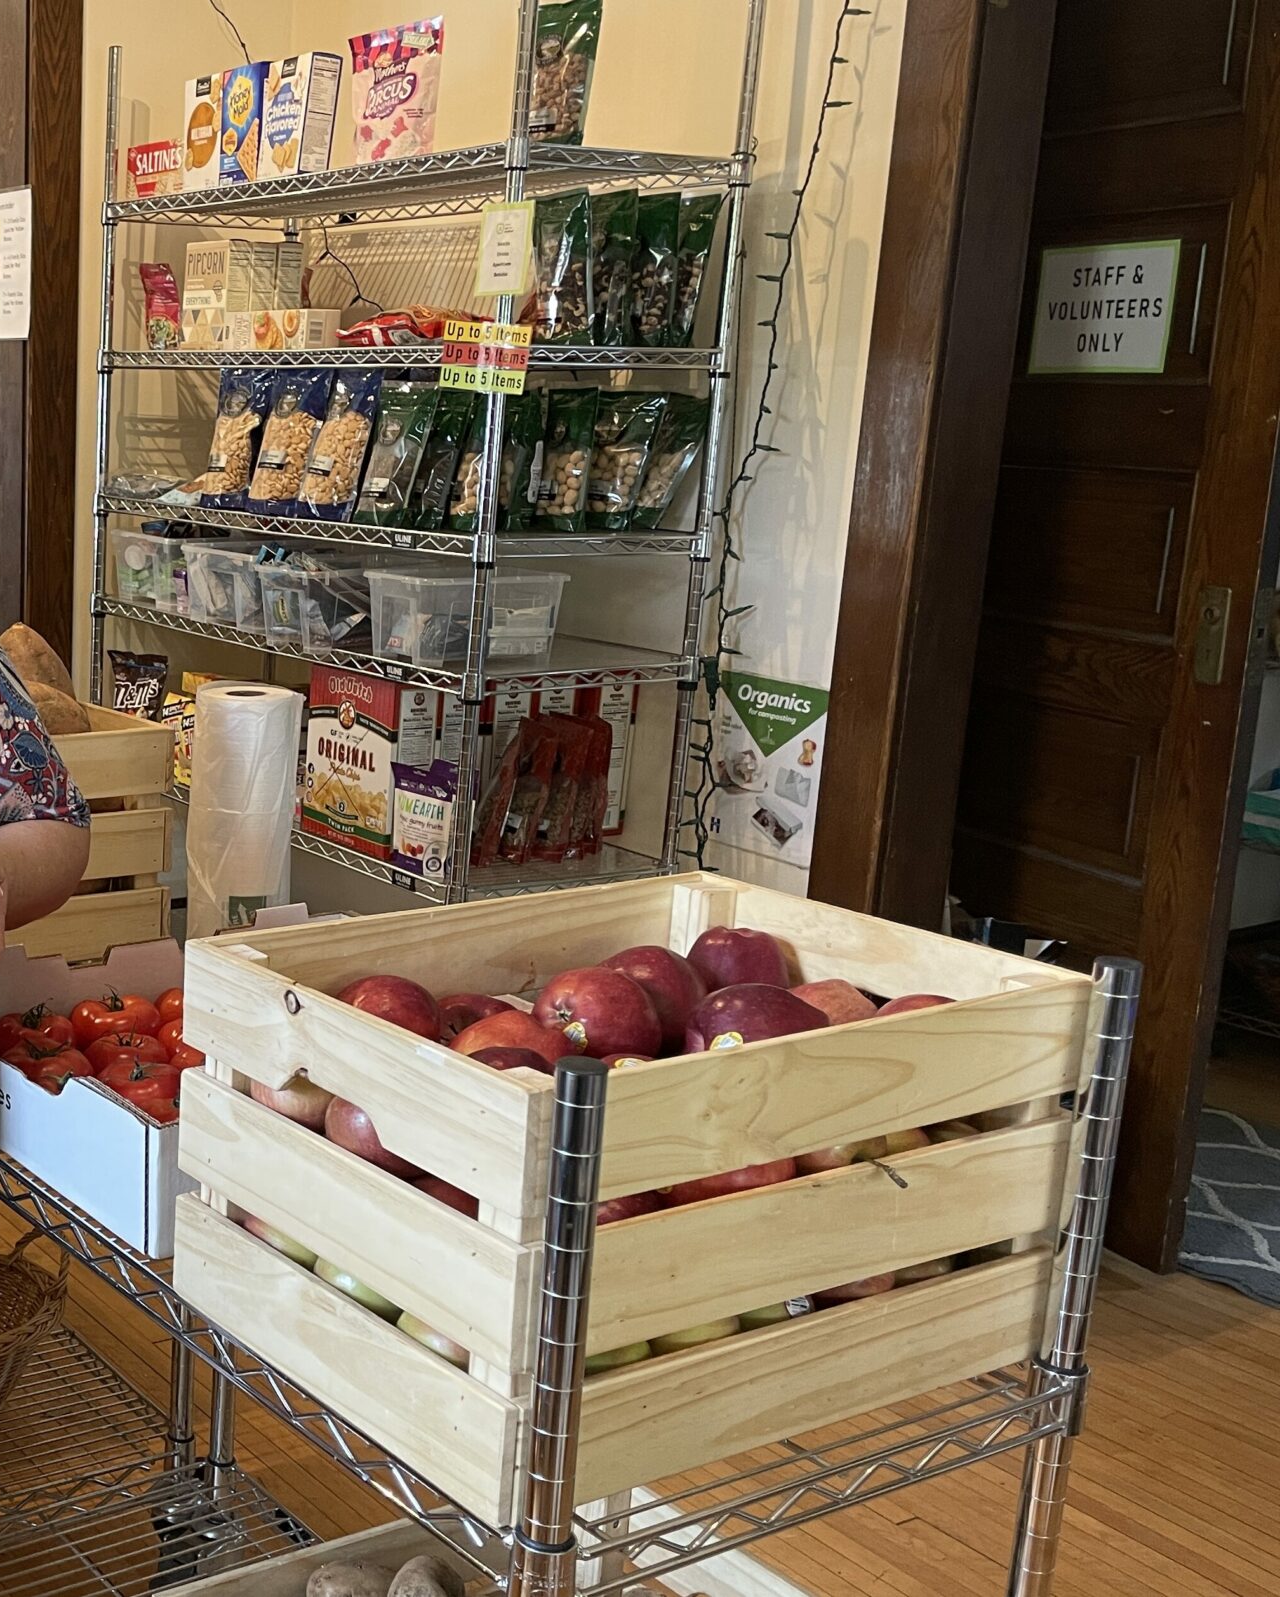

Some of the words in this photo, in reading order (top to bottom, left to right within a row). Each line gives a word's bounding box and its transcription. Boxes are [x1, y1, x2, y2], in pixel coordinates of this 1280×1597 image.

[229, 85, 251, 109] Honey
[266, 99, 301, 121] Chicken
[265, 116, 299, 134] Flavored
[135, 147, 183, 175] SALTINES
[187, 251, 226, 276] PIPCORN
[1072, 265, 1127, 288] STAFF
[1132, 264, 1144, 285] &
[1048, 297, 1163, 321] VOLUNTEERS
[448, 322, 464, 340] Up
[469, 326, 481, 339] to
[483, 328, 492, 340] 5
[495, 329, 528, 343] Items
[1077, 332, 1124, 353] ONLY
[445, 345, 463, 361] Up
[468, 348, 479, 360] to
[483, 349, 490, 361] 5
[495, 350, 526, 364] Items
[443, 368, 460, 385] Up
[465, 371, 475, 384] to
[480, 372, 487, 385] 5
[491, 372, 522, 389] Items
[328, 676, 345, 694] Old
[345, 676, 374, 704] Dutch
[736, 682, 812, 715] Organics
[748, 707, 758, 717] for
[757, 709, 797, 725] composting
[318, 736, 376, 773] ORIGINAL
[327, 817, 342, 829] TWIN
[341, 822, 356, 833] PACK
